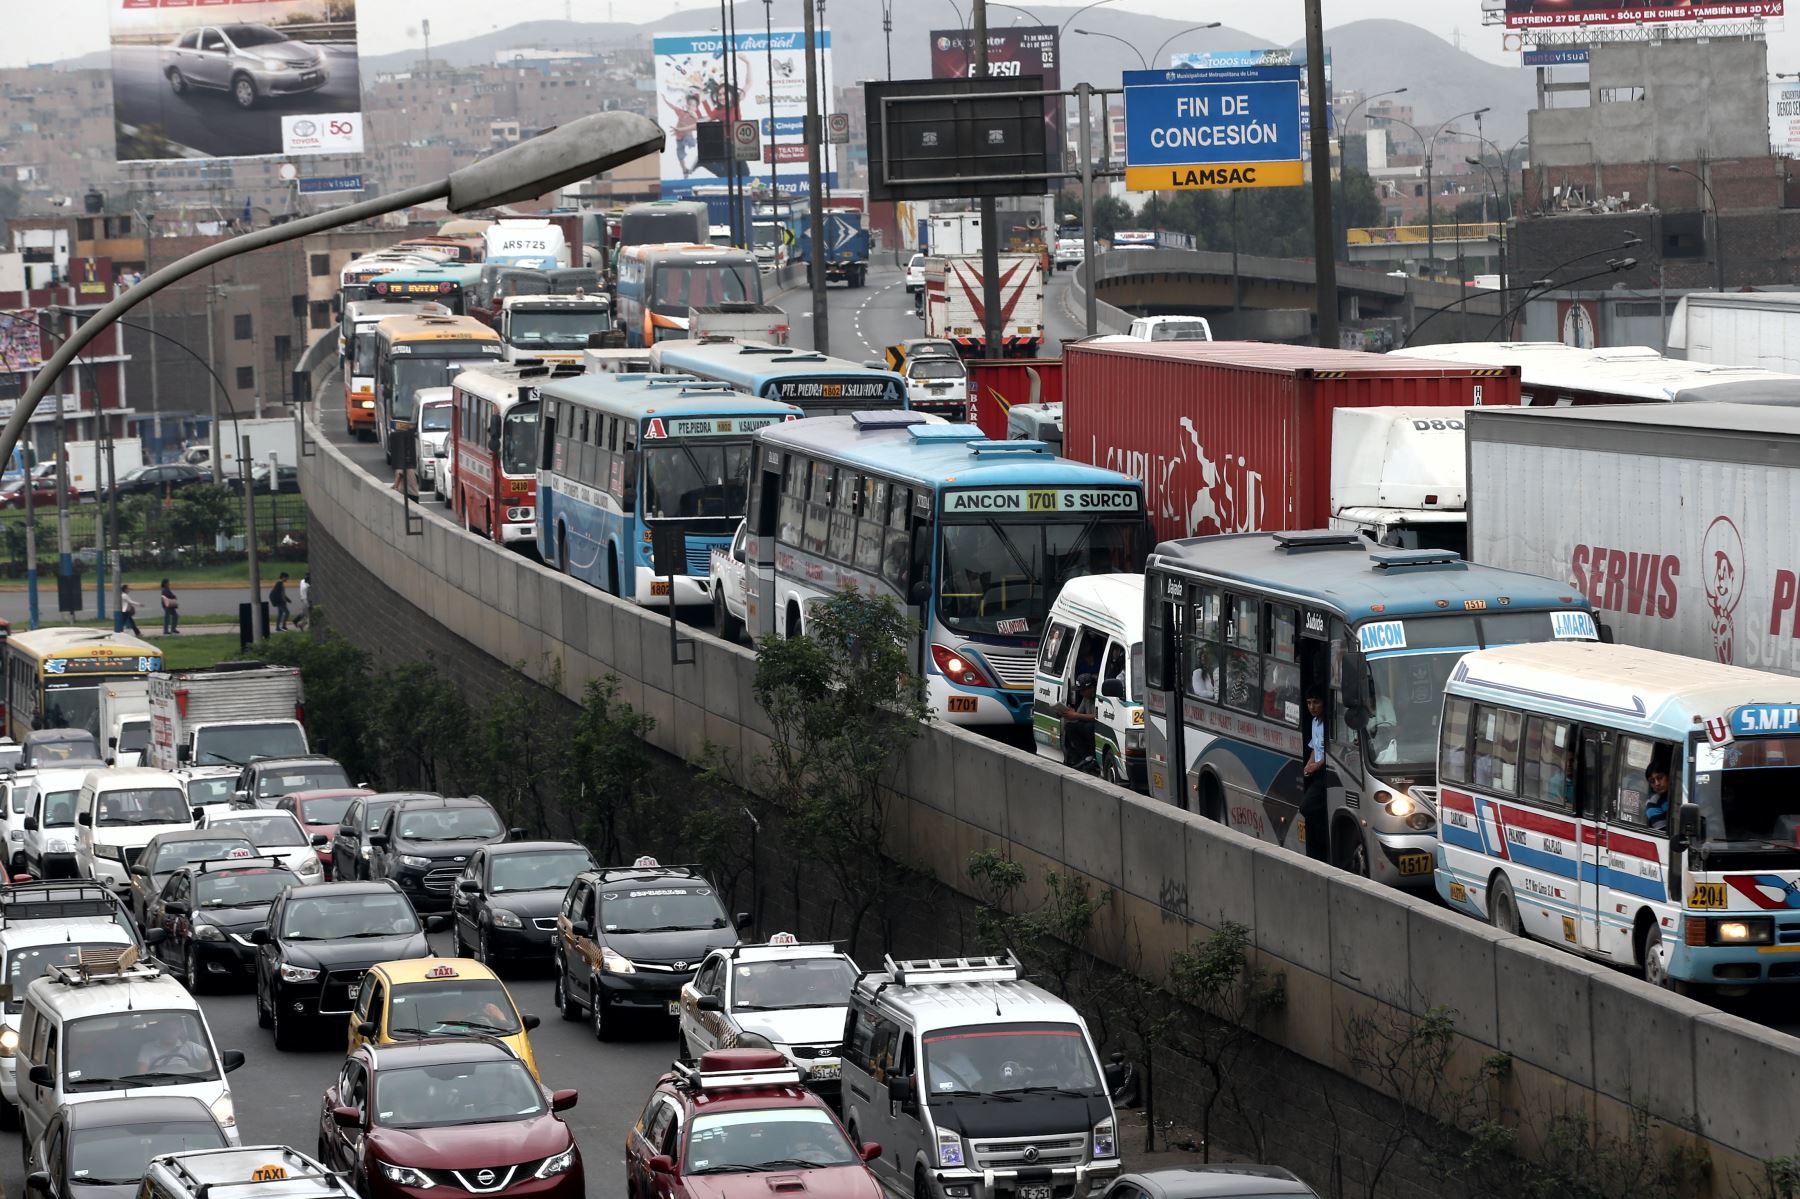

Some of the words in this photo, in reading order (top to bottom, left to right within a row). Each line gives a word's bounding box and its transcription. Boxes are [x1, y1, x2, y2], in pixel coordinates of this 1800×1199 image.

[1511, 15, 1553, 25] ESTRENO
[1568, 14, 1581, 22] DE
[1582, 13, 1609, 21] ABRIL
[1617, 10, 1641, 19] SÓLO
[1643, 10, 1656, 18] EN
[1658, 8, 1686, 18] CINES
[1692, 5, 1734, 17] TAMBIÉN
[1735, 5, 1748, 14] EN
[1749, 4, 1762, 13] 3D
[691, 41, 724, 52] TODA
[1042, 52, 1054, 62] 02
[1208, 57, 1239, 67] TODOS
[1208, 71, 1240, 79] Metropolitana
[1176, 97, 1209, 118] FIN
[1221, 95, 1249, 116] DE
[330, 120, 353, 135] 50
[739, 127, 752, 138] 40
[1150, 119, 1277, 149] CONCESIÓN
[1172, 168, 1256, 187] LAMSAC
[781, 383, 797, 396] PTE.
[797, 383, 823, 396] PIEDRA
[841, 383, 884, 397] V.SALVADOR
[644, 418, 668, 439] A
[954, 494, 1020, 509] ANCON
[1028, 492, 1056, 509] 1701
[1064, 493, 1075, 508] S
[1079, 493, 1133, 508] SURCO
[1167, 577, 1183, 600] Bajada
[1571, 543, 1680, 620] SERVIS
[1465, 600, 1486, 610] 1517
[1305, 611, 1324, 632] Subida
[1555, 615, 1594, 637] J.MARIA
[1361, 622, 1404, 651] ANCON
[949, 697, 978, 711] 1701
[1706, 716, 1727, 743] U
[639, 859, 656, 867] TAXI
[1400, 855, 1429, 874] 1517
[1691, 886, 1724, 907] 2204
[773, 935, 794, 945] TAXI
[433, 967, 453, 976] TAXI
[255, 1167, 284, 1181] TAXI
